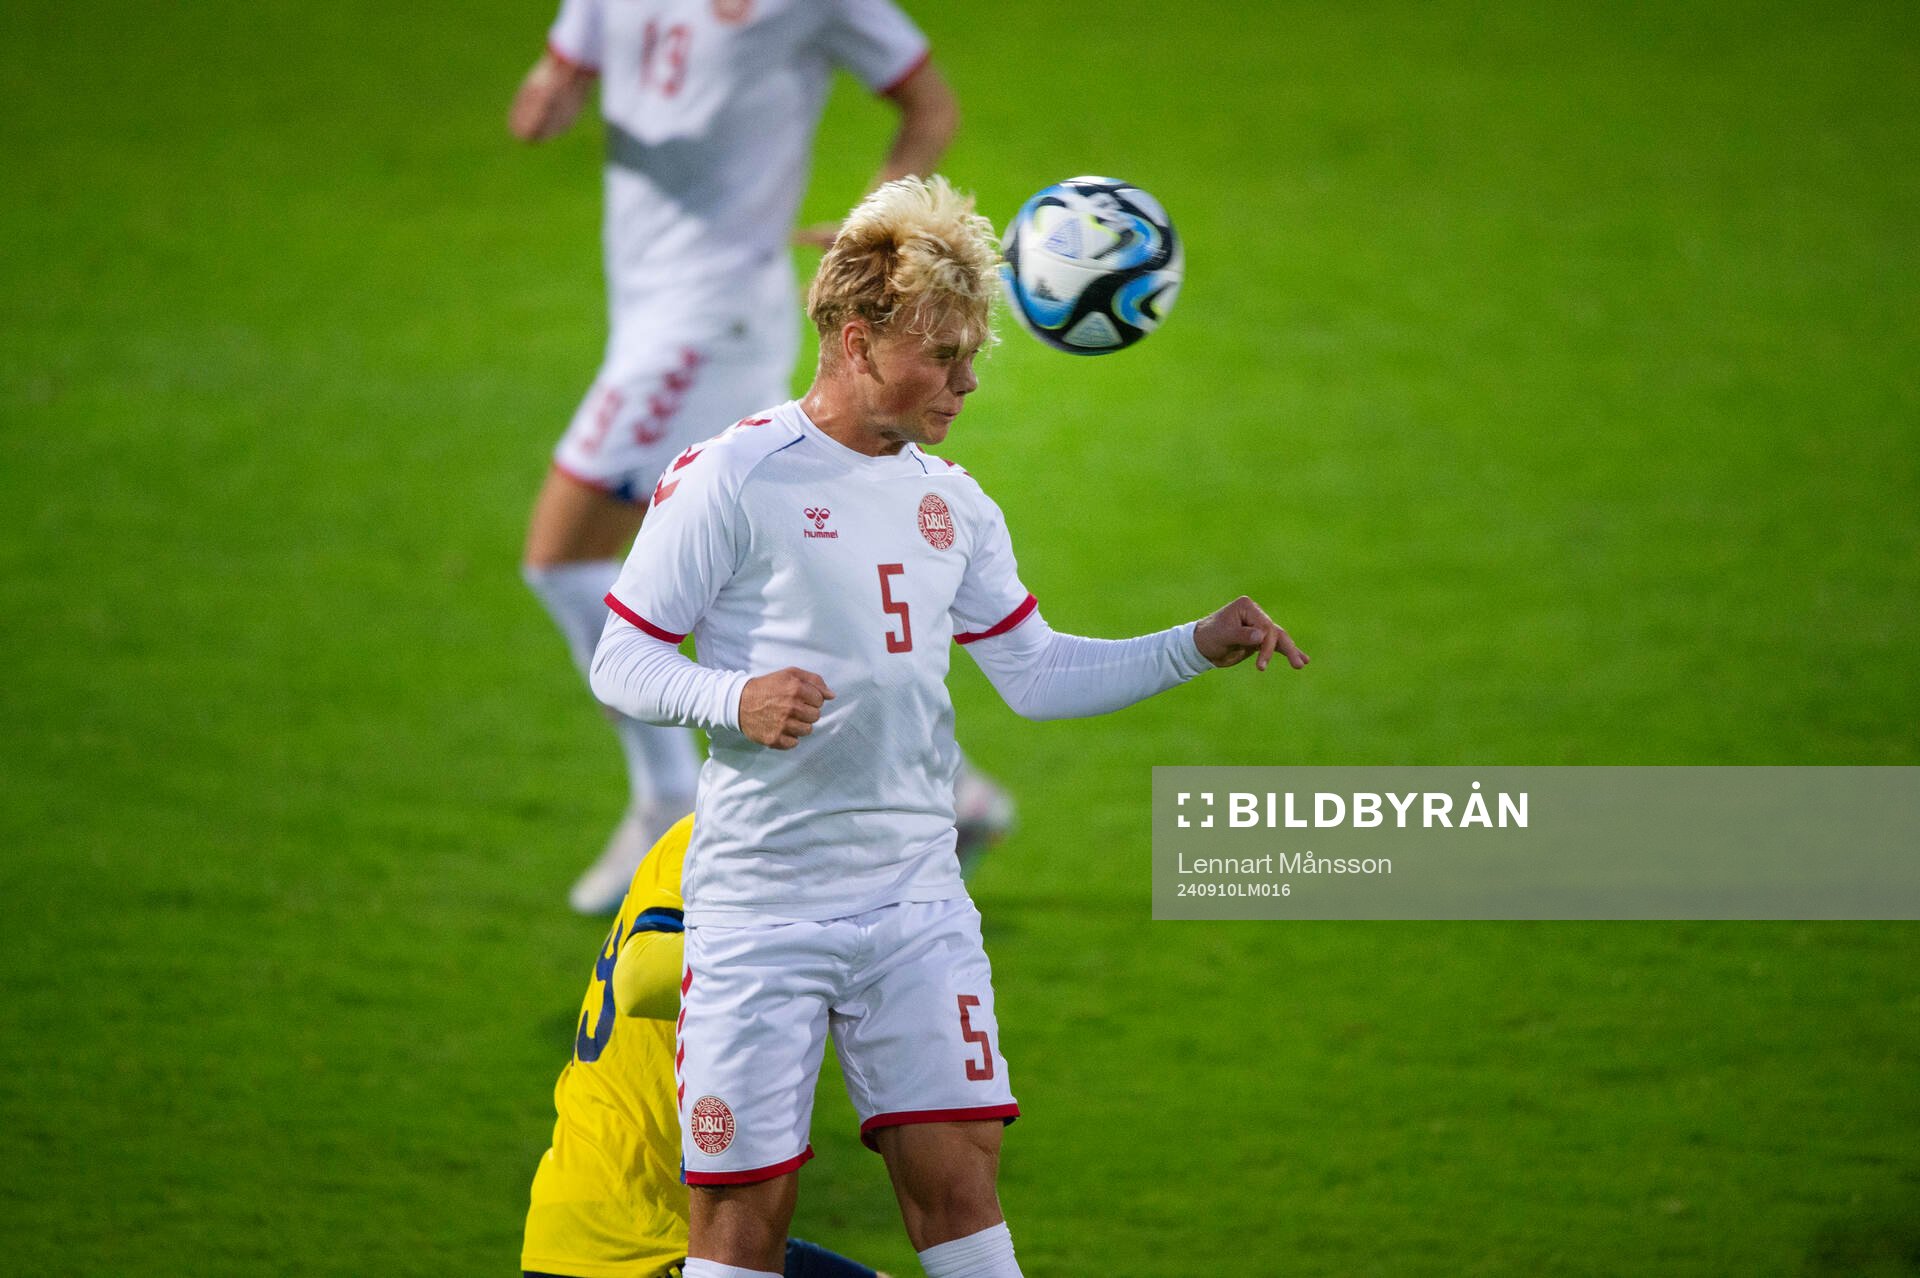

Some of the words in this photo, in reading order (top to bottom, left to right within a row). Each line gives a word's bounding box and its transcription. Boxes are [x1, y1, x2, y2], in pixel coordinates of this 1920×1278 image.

[639, 20, 692, 97] 13
[924, 512, 947, 530] DBU
[803, 529, 838, 538] hummel
[877, 563, 913, 654] 5
[957, 994, 994, 1081] 5
[699, 1115, 725, 1133] DBU
[703, 1145, 722, 1154] 1889
